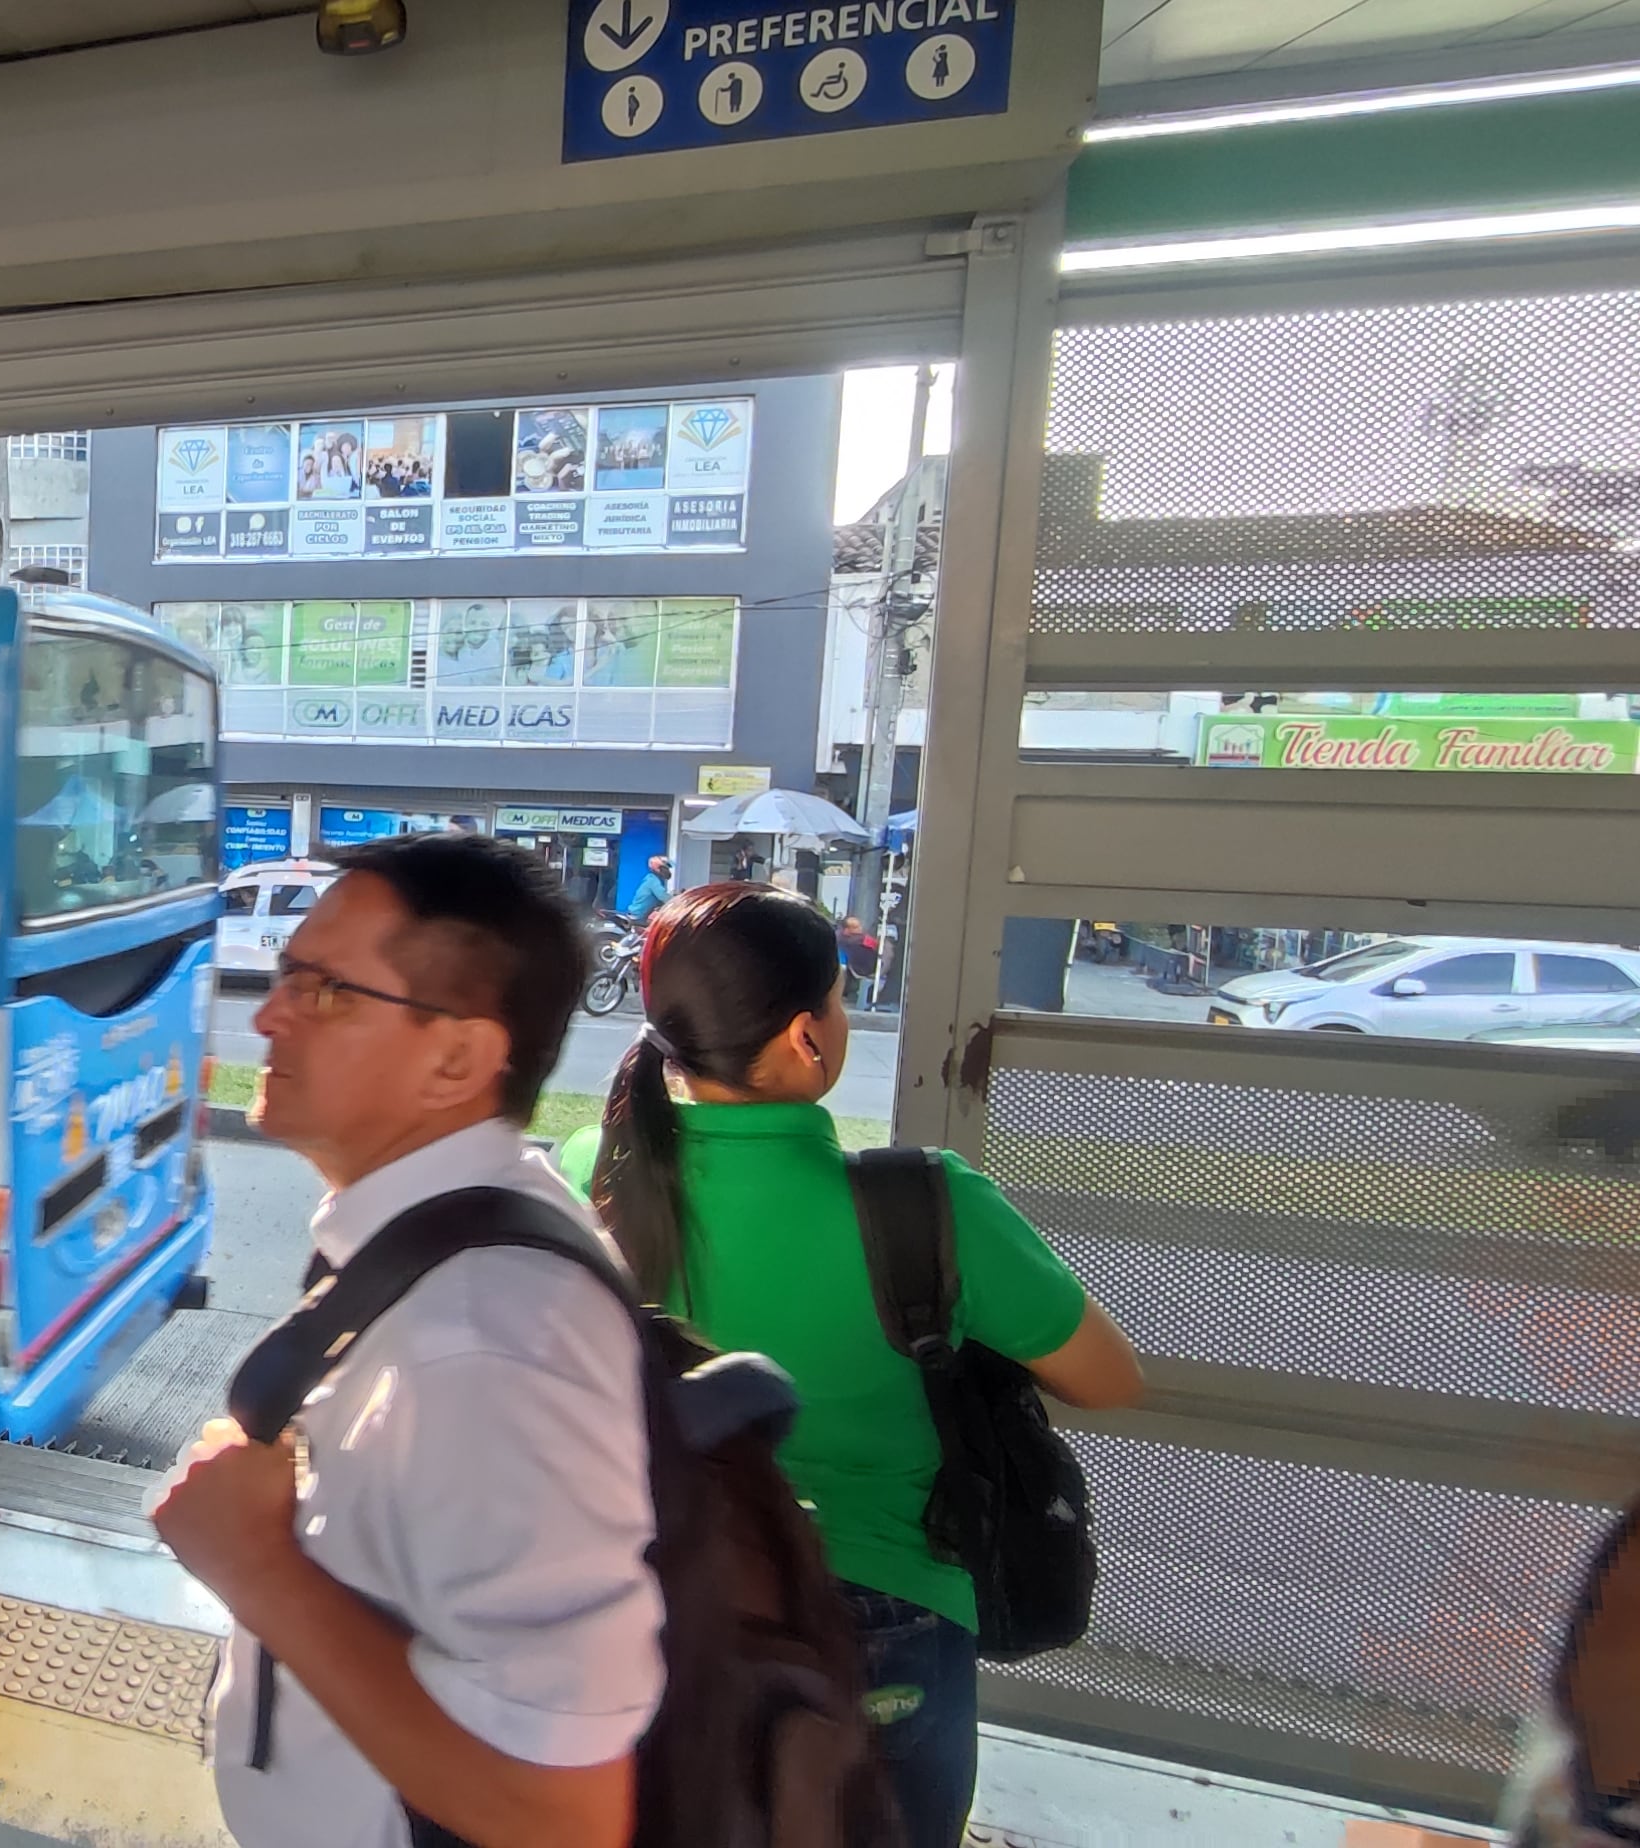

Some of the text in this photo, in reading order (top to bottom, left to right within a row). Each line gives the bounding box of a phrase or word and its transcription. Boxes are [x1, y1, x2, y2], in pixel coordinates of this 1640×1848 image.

[683, 0, 999, 61] PREFERENCIAL
[694, 461, 720, 472] LEA
[183, 485, 205, 495] LEA
[449, 504, 507, 514] SEGURIDAD
[458, 514, 496, 522] SOCIAL
[315, 522, 339, 532] POR
[390, 521, 406, 532] DE
[306, 534, 348, 545] CICLOS
[371, 533, 425, 545] EVENTOS
[363, 618, 382, 631] de
[1277, 721, 1615, 772] Tienda Familiar
[561, 815, 617, 827] MEDICAS
